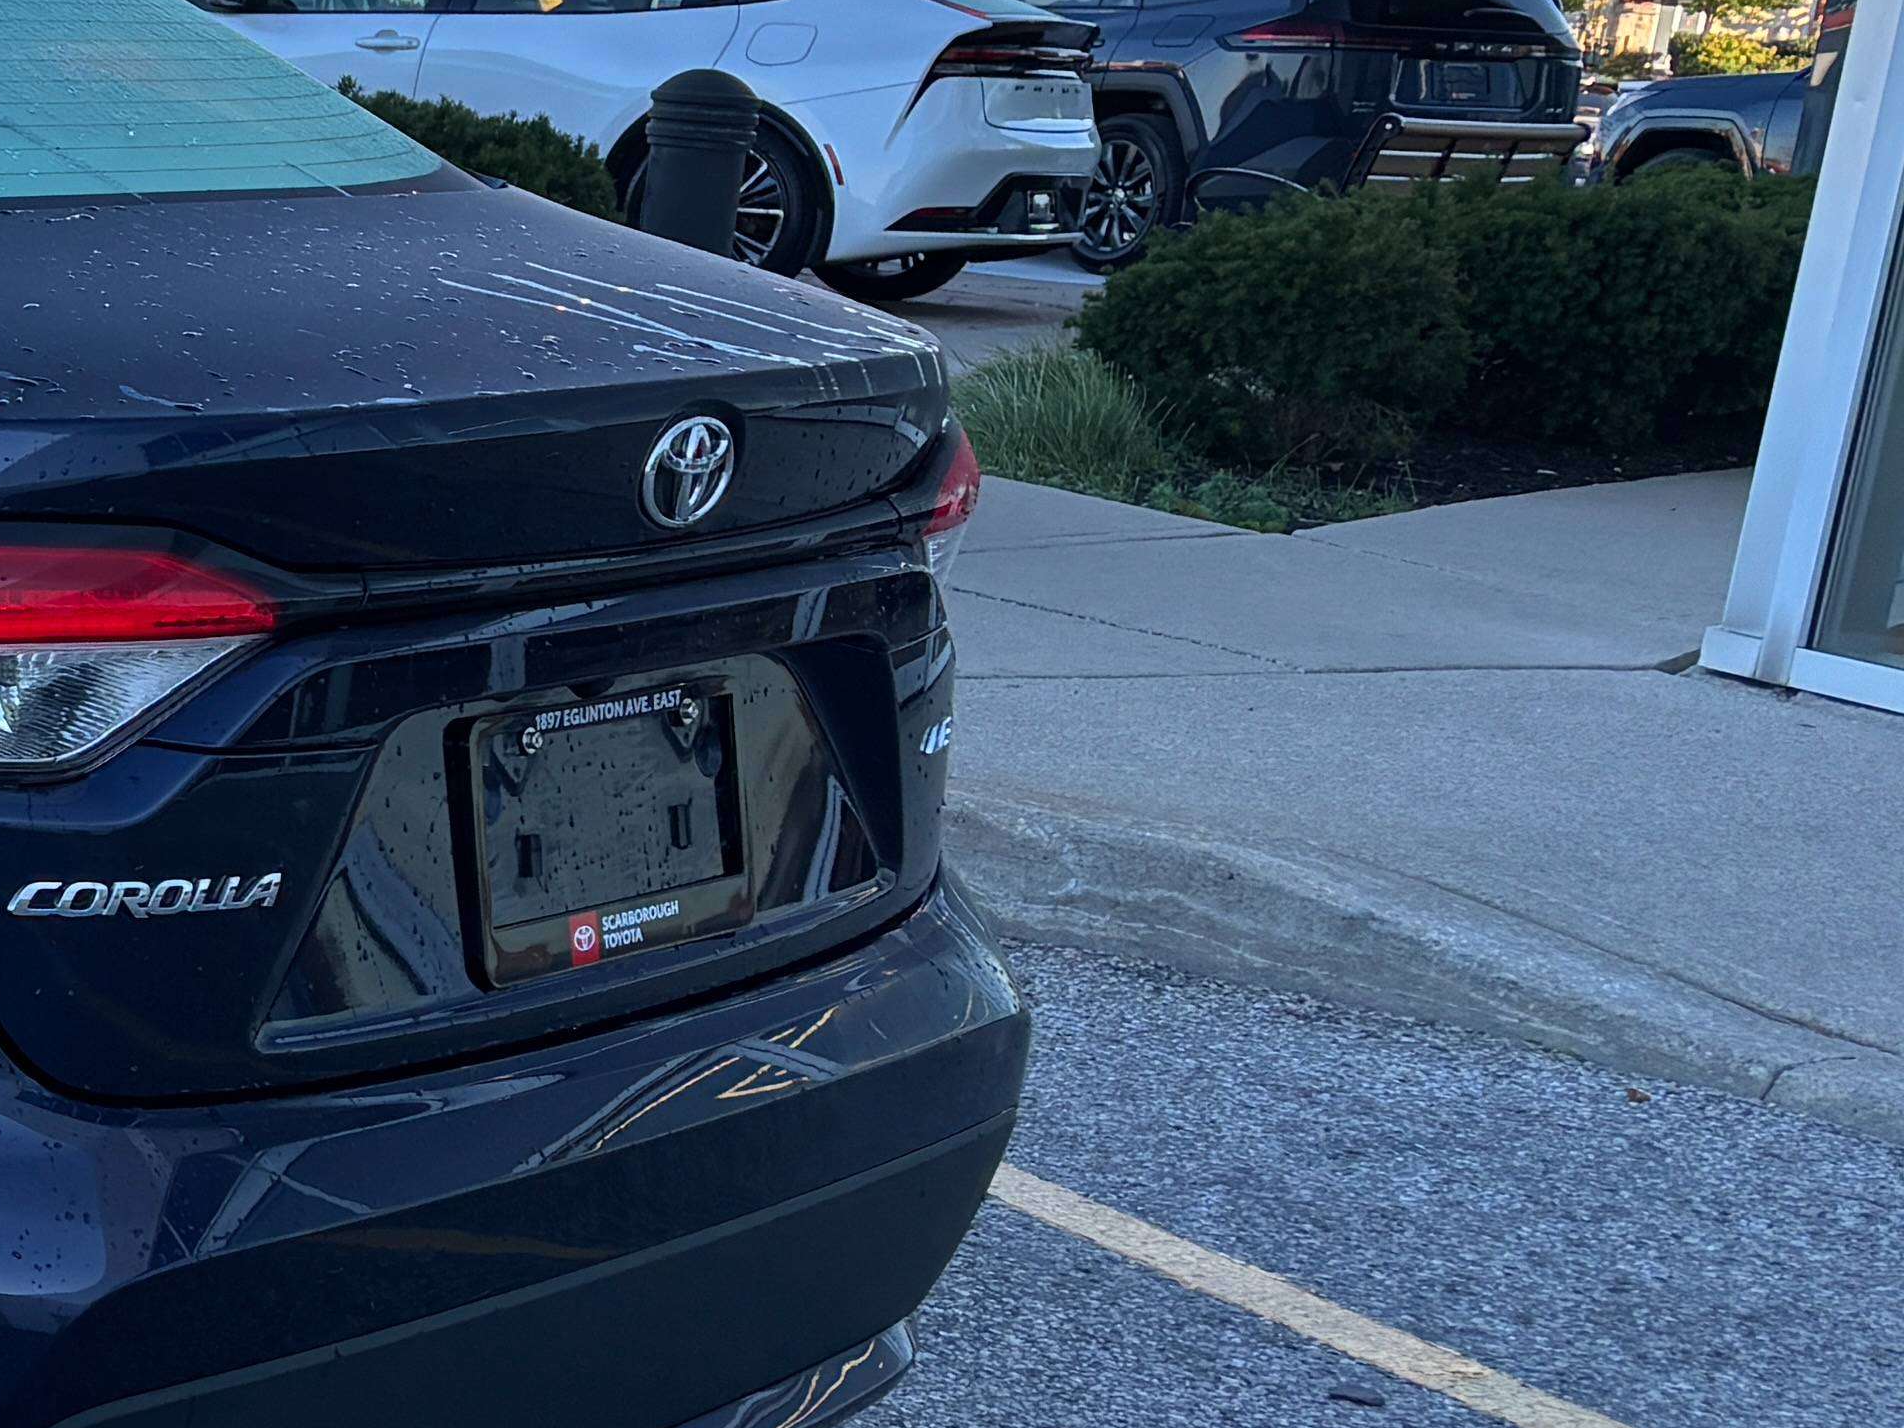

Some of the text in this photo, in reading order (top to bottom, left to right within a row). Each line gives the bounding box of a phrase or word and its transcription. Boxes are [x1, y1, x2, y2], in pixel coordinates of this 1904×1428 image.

[535, 689, 682, 730] 1897 EGLINTON AVE. EAST
[6, 871, 283, 919] COROLLA
[601, 899, 680, 932] SCARBOROUGH
[602, 927, 644, 949] TOYOTA
